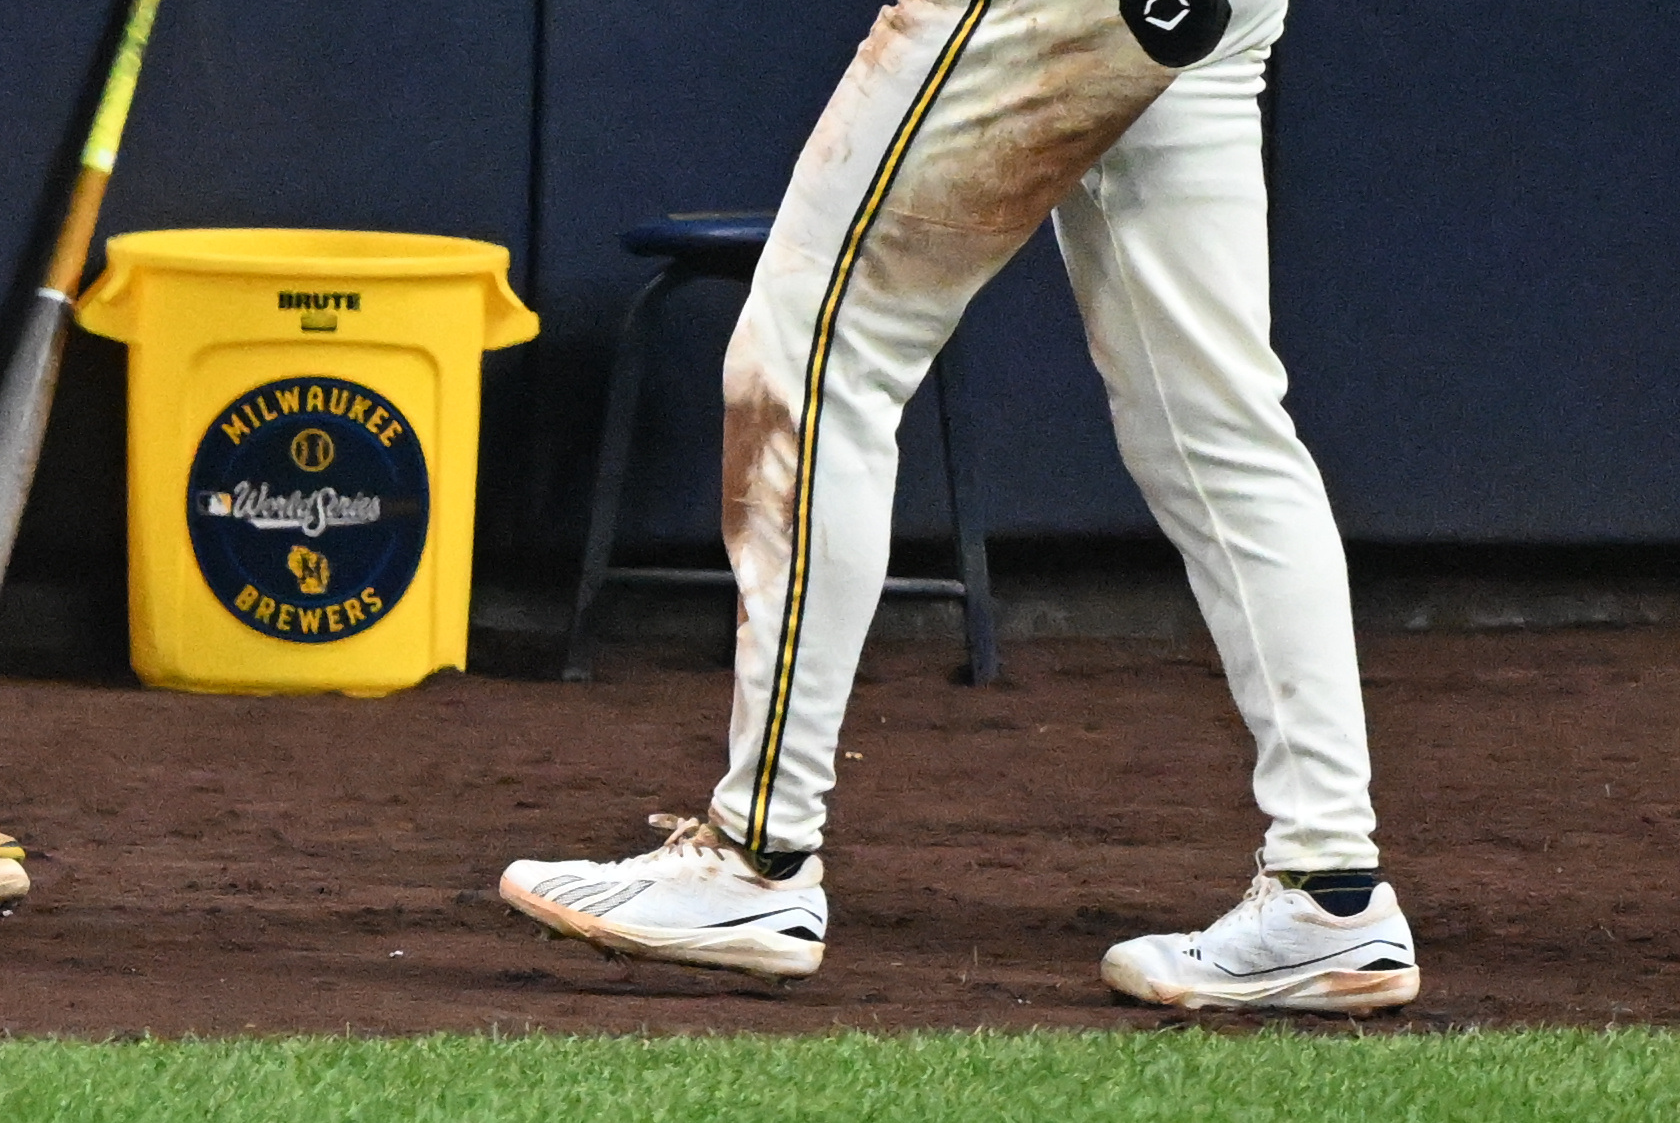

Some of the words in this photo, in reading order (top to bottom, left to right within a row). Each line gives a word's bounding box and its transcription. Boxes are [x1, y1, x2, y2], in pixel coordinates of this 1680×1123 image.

[277, 290, 362, 312] BRUTE
[221, 385, 404, 447] MILWAUKEE
[233, 480, 309, 521] World
[302, 486, 381, 538] Series
[233, 583, 384, 635] BREWERS
